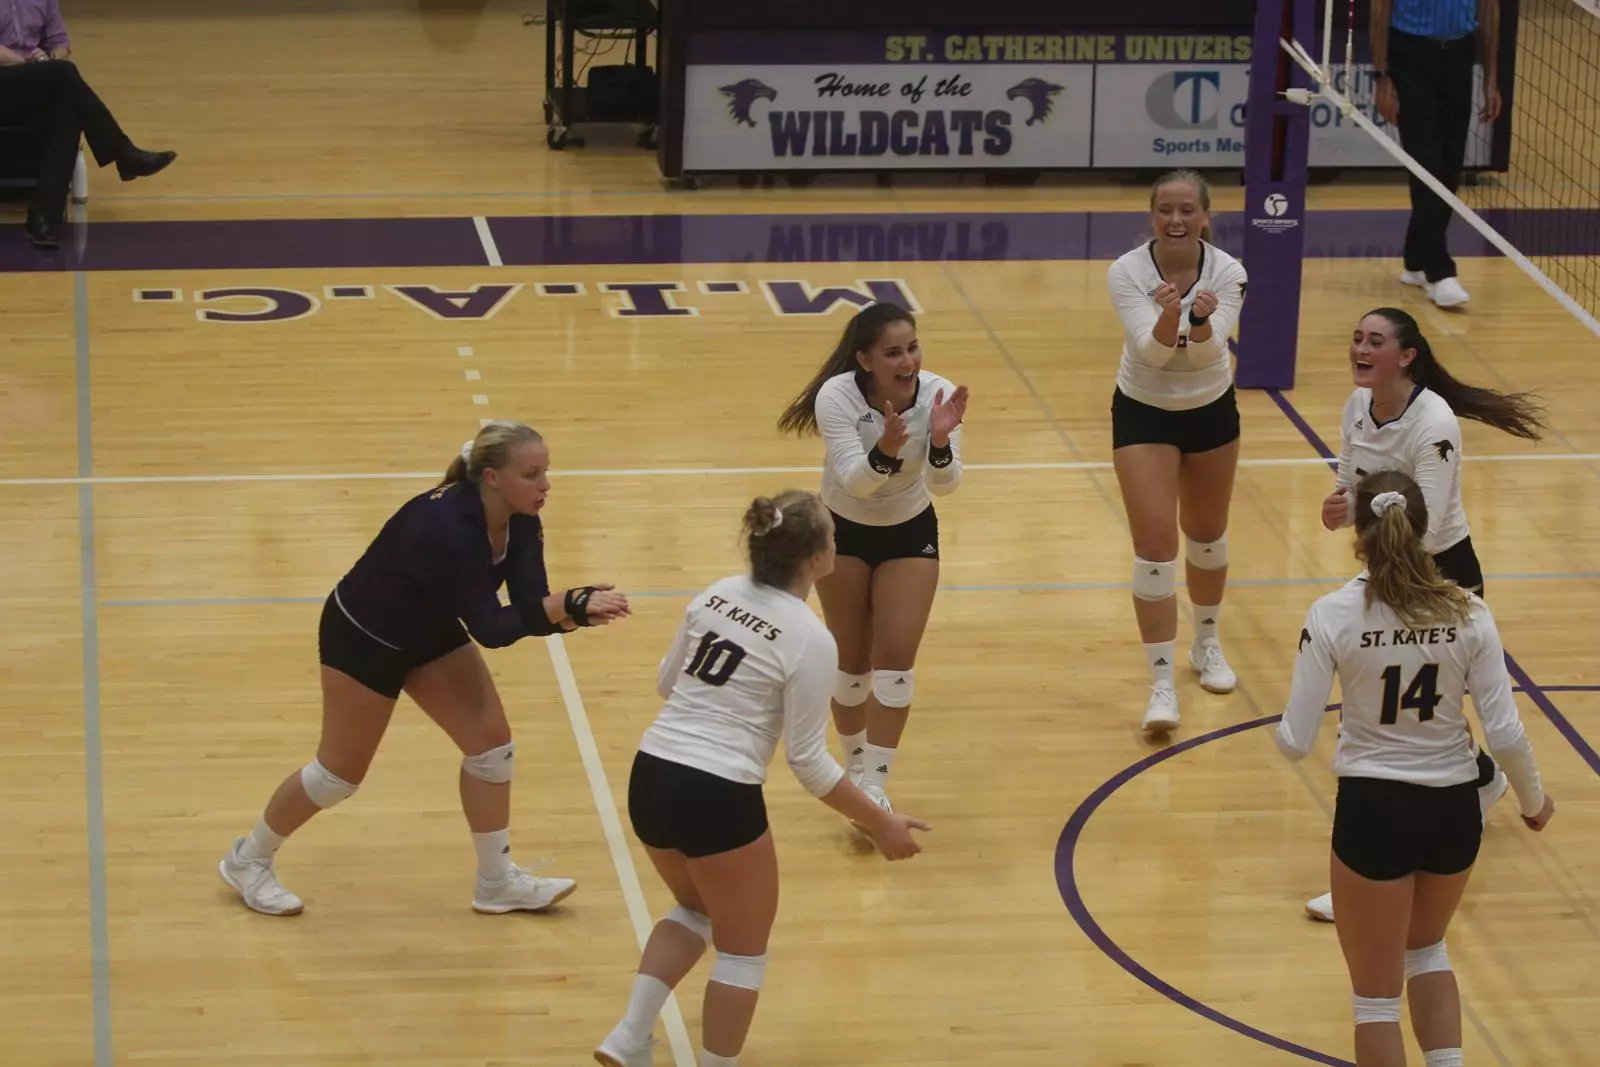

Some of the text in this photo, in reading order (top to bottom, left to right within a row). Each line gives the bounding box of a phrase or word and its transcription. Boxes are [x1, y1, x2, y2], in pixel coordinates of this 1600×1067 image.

[885, 35, 1252, 61] ST. CATHERINE UNIVERS
[813, 73, 973, 104] Home of the
[768, 110, 1013, 157] WILDCATS
[1152, 137, 1212, 156] Sports
[704, 595, 783, 641] ST. KATE'S
[1360, 626, 1457, 648] ST. KATE'S
[684, 630, 747, 687] 10
[1379, 663, 1443, 725] 14
